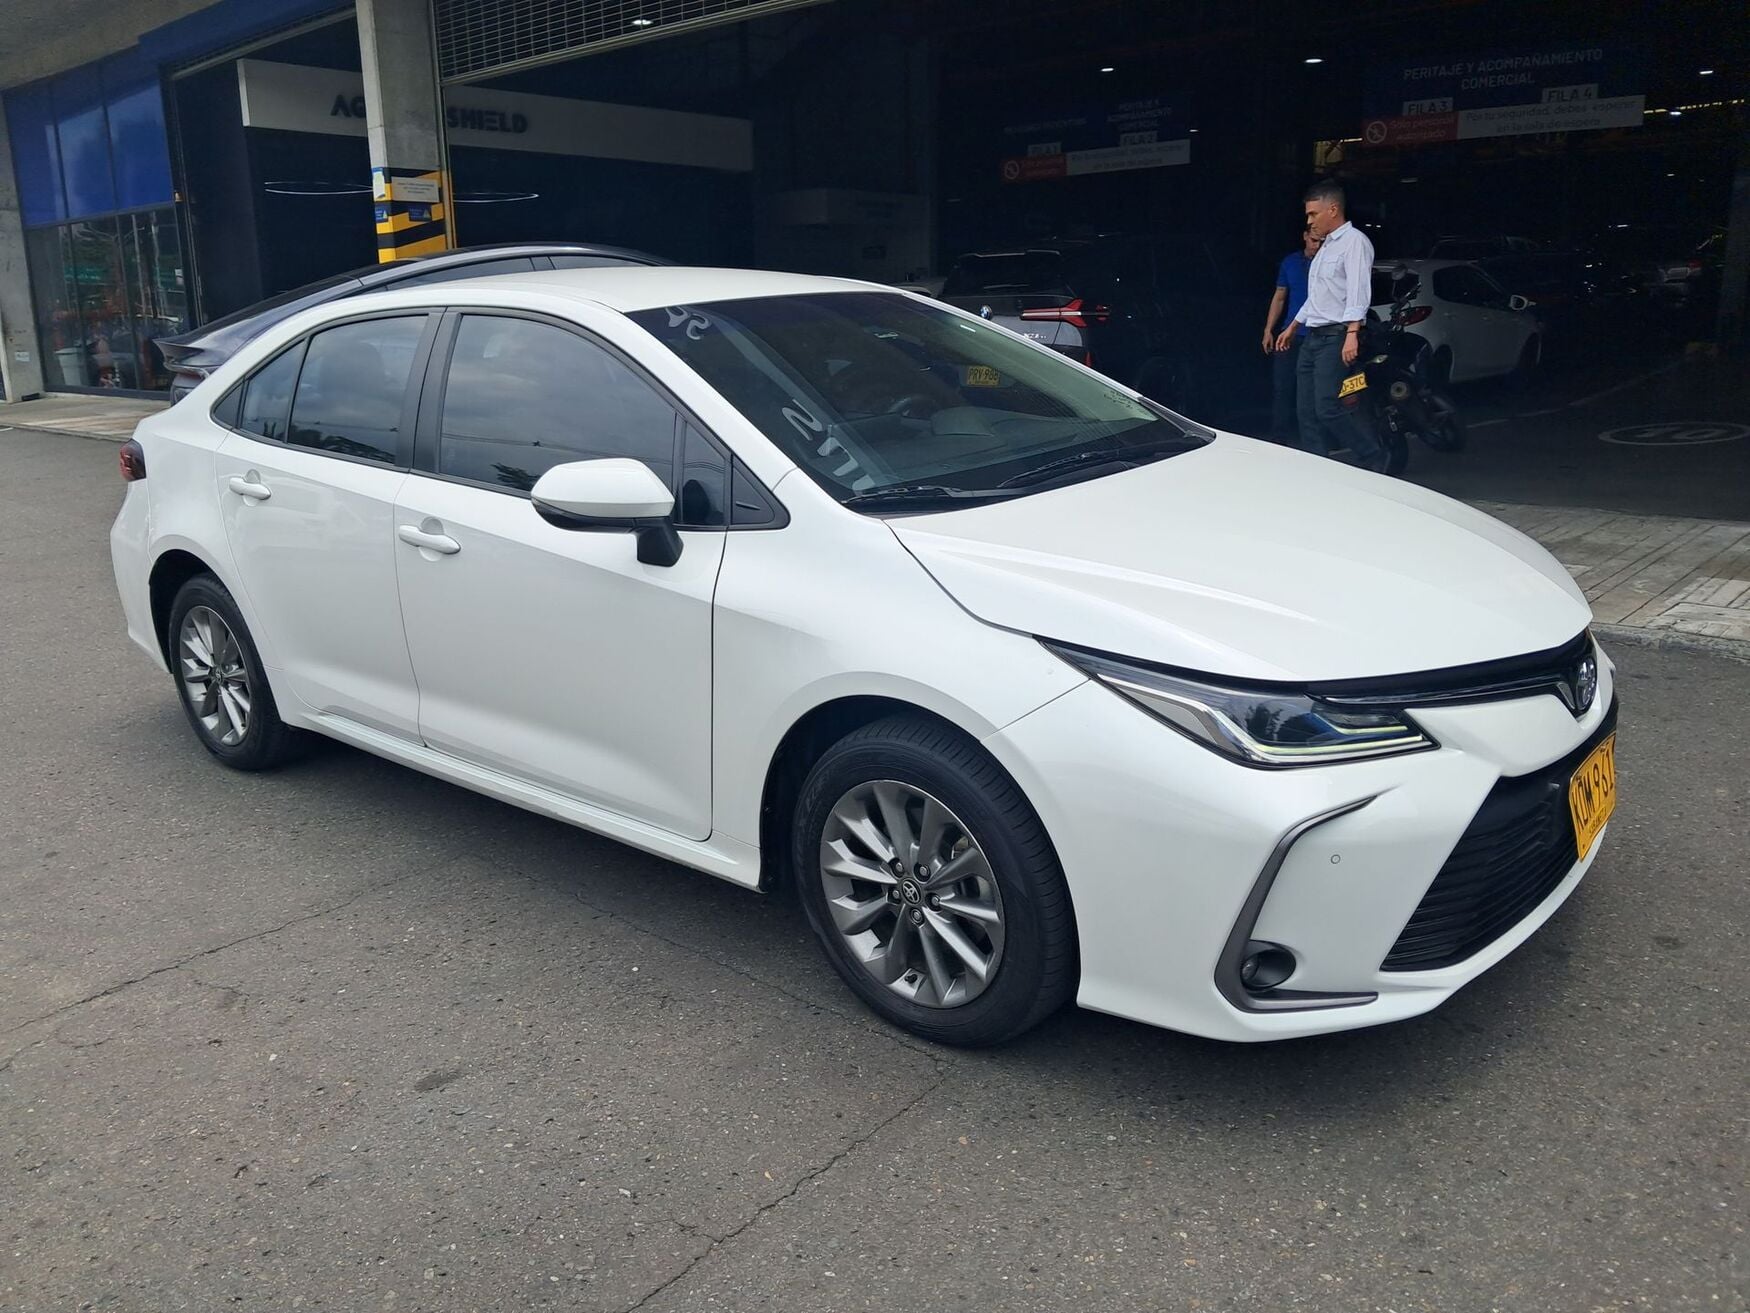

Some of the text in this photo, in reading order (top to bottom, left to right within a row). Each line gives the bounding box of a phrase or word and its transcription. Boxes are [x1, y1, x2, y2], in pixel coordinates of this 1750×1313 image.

[1402, 48, 1604, 81] PERITAJE Y ACOMPAÑAMIENTO
[1461, 73, 1536, 91] COMERCIAL
[1549, 87, 1593, 102] FILA 4
[1407, 100, 1449, 116] FILA 3
[447, 105, 529, 134] SHIELD
